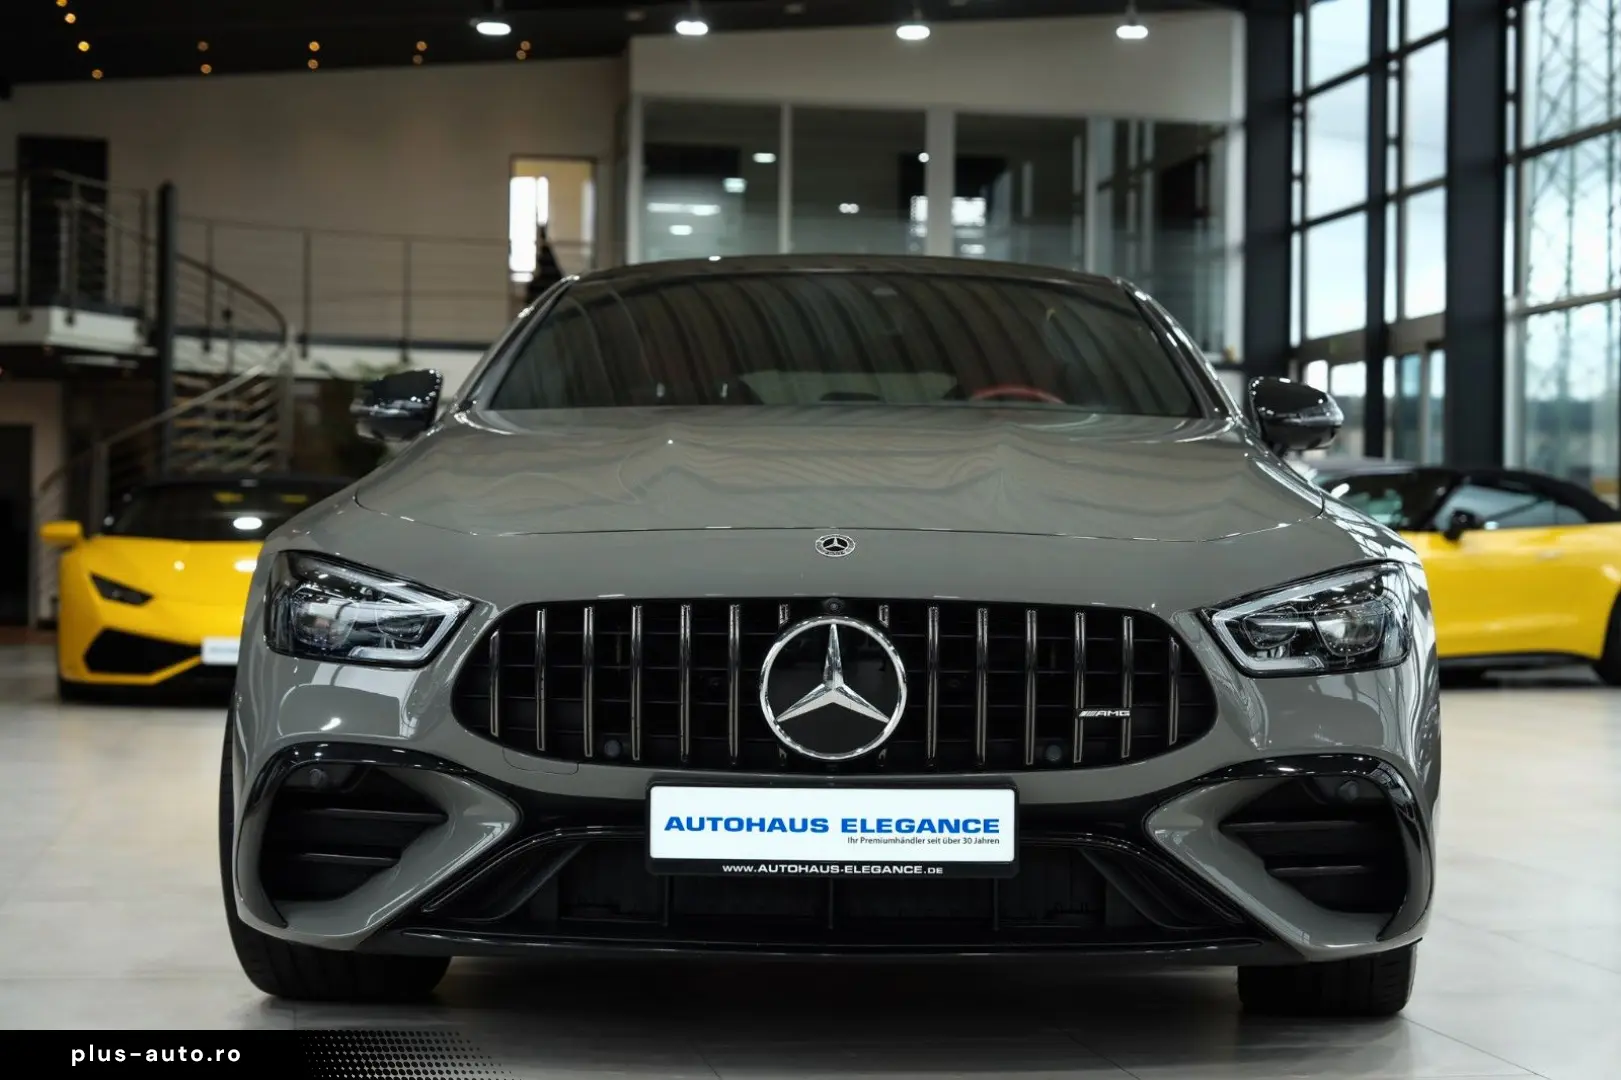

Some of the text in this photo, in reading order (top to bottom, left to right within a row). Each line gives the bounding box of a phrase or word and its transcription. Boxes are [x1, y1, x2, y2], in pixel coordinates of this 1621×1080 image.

[664, 816, 1000, 834] AUTOHAUS ELEGANCE
[847, 836, 1000, 845] Ihr Premiumhändler seit über 30 Jahren
